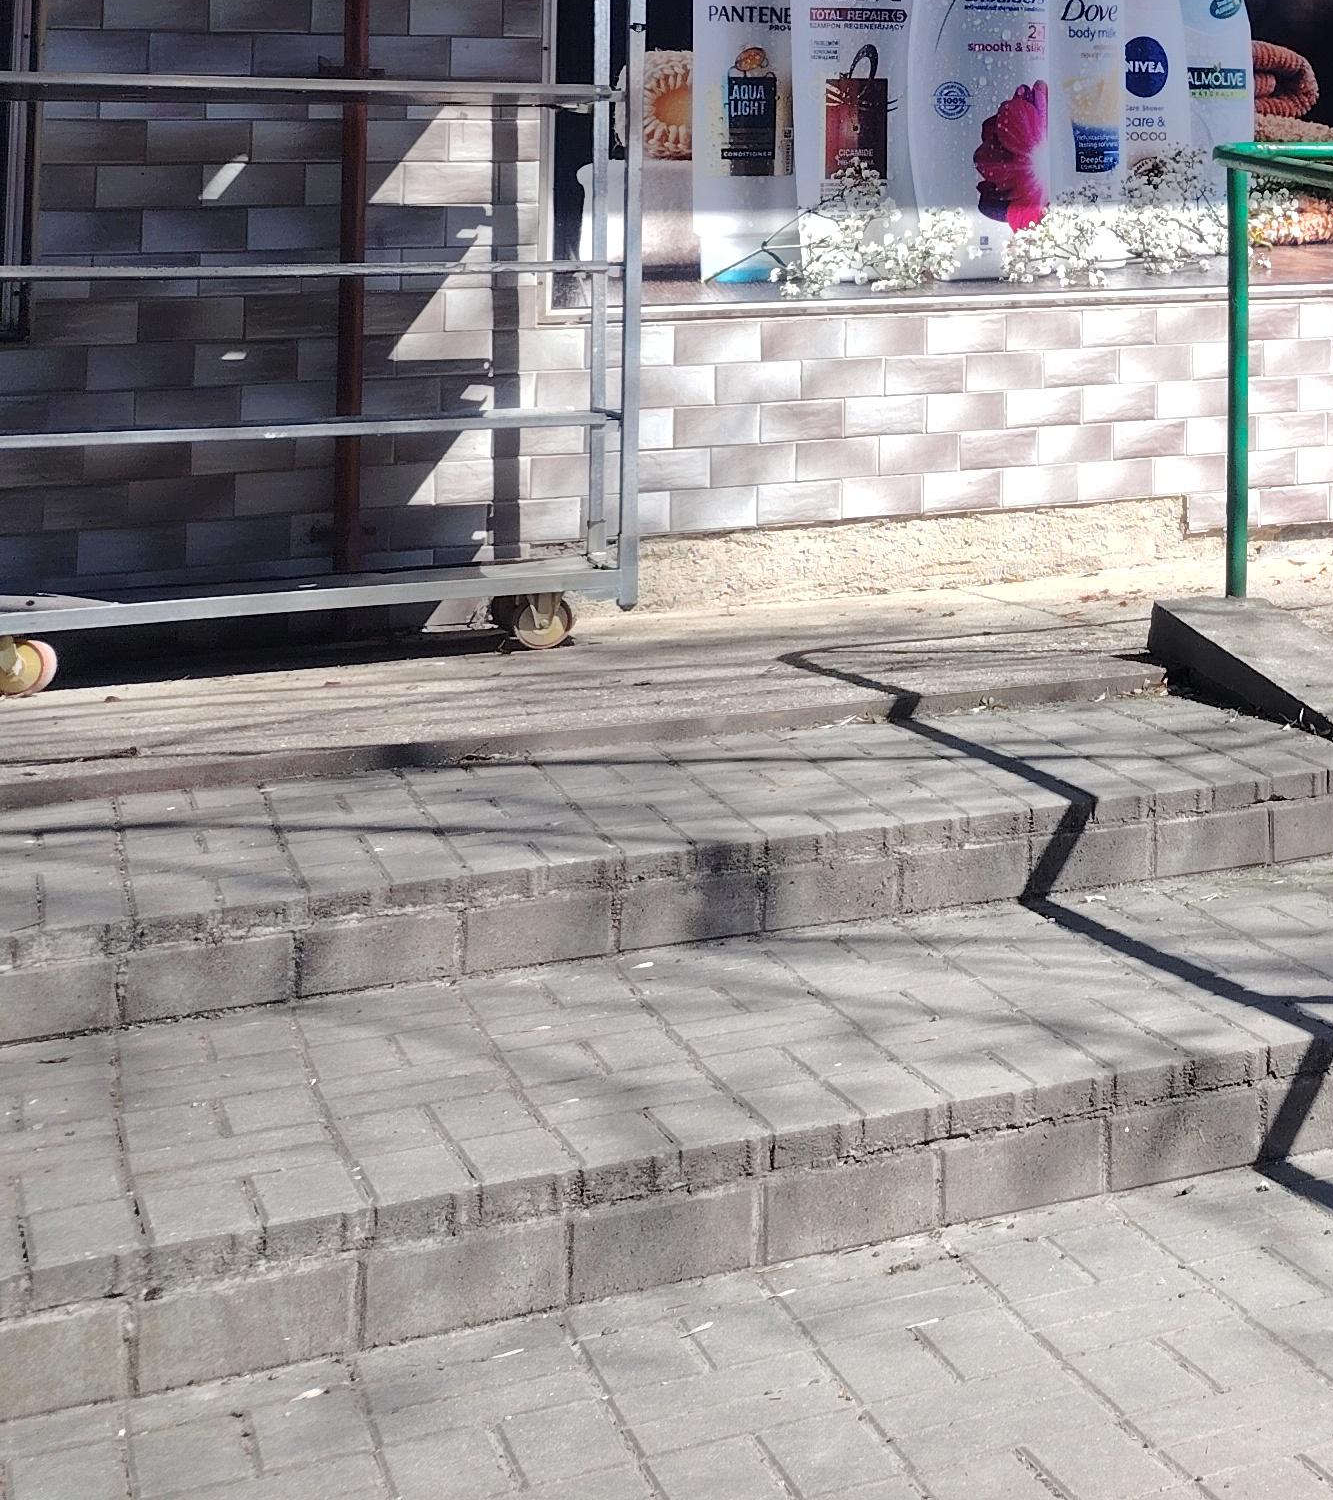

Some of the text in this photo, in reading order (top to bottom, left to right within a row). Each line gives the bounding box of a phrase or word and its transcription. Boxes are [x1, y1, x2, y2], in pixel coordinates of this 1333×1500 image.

[708, 4, 792, 25] PANTENE
[811, 9, 842, 21] TOTAL
[847, 10, 889, 22] REPAIR
[1068, 25, 1096, 41] body
[967, 42, 1047, 54] smooth & silky
[1126, 61, 1165, 74] NIVEA
[1187, 71, 1244, 87] ALMOLIVE
[731, 84, 766, 100] AQUA
[730, 100, 767, 117] LIGHT
[1157, 116, 1165, 127] &
[723, 150, 773, 158] CONDITIONER
